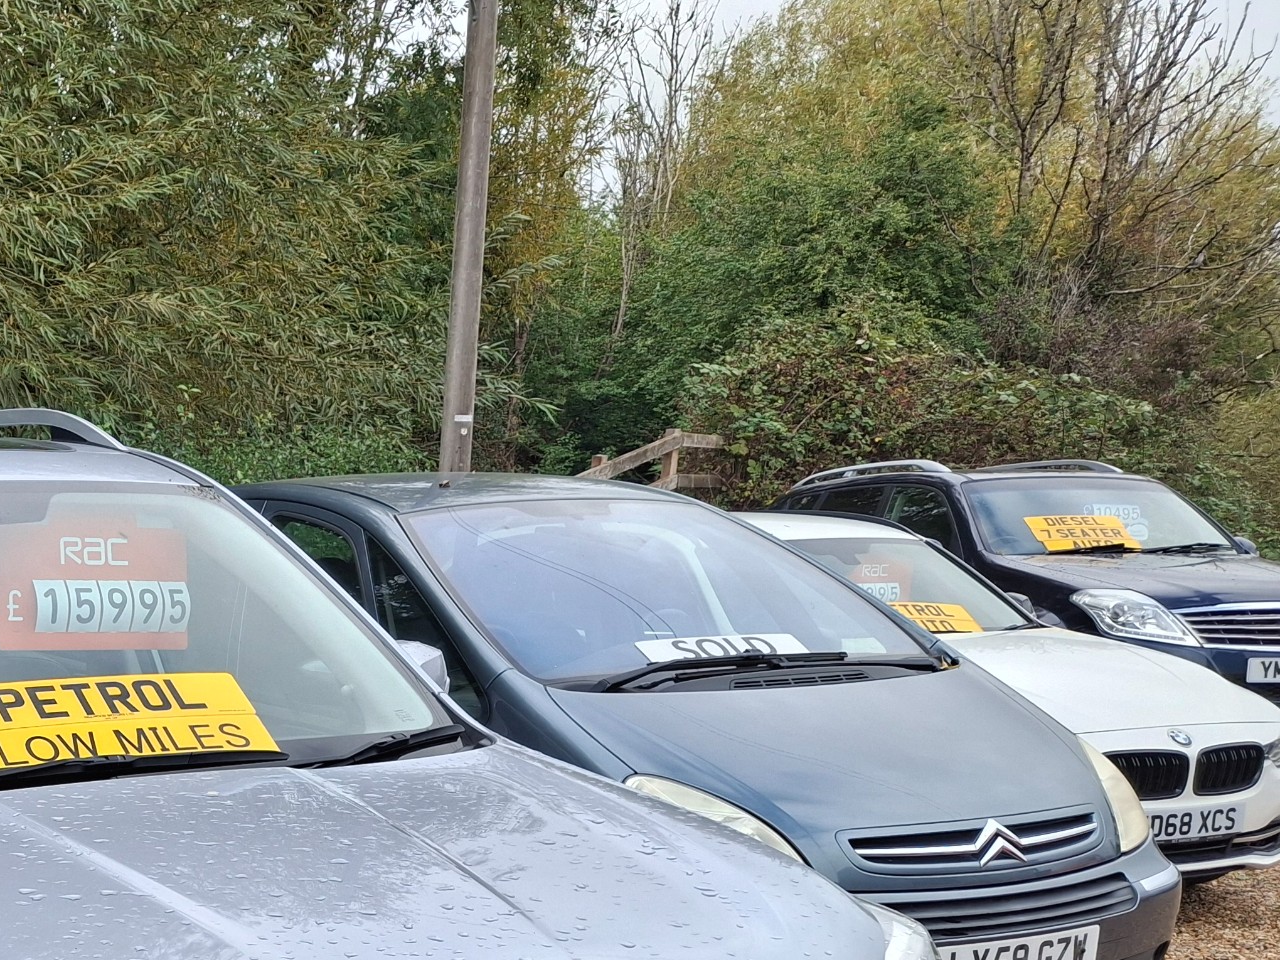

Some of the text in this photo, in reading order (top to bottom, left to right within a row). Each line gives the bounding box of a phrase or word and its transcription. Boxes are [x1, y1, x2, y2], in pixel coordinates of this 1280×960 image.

[1043, 516, 1105, 526] DIESEL
[1040, 529, 1052, 539] 7
[1056, 528, 1124, 538] SEATER
[6, 587, 187, 625] £ 15995
[890, 604, 955, 617] TROL
[112, 723, 251, 755] MILES
[1147, 807, 1237, 838] D68 XCS
